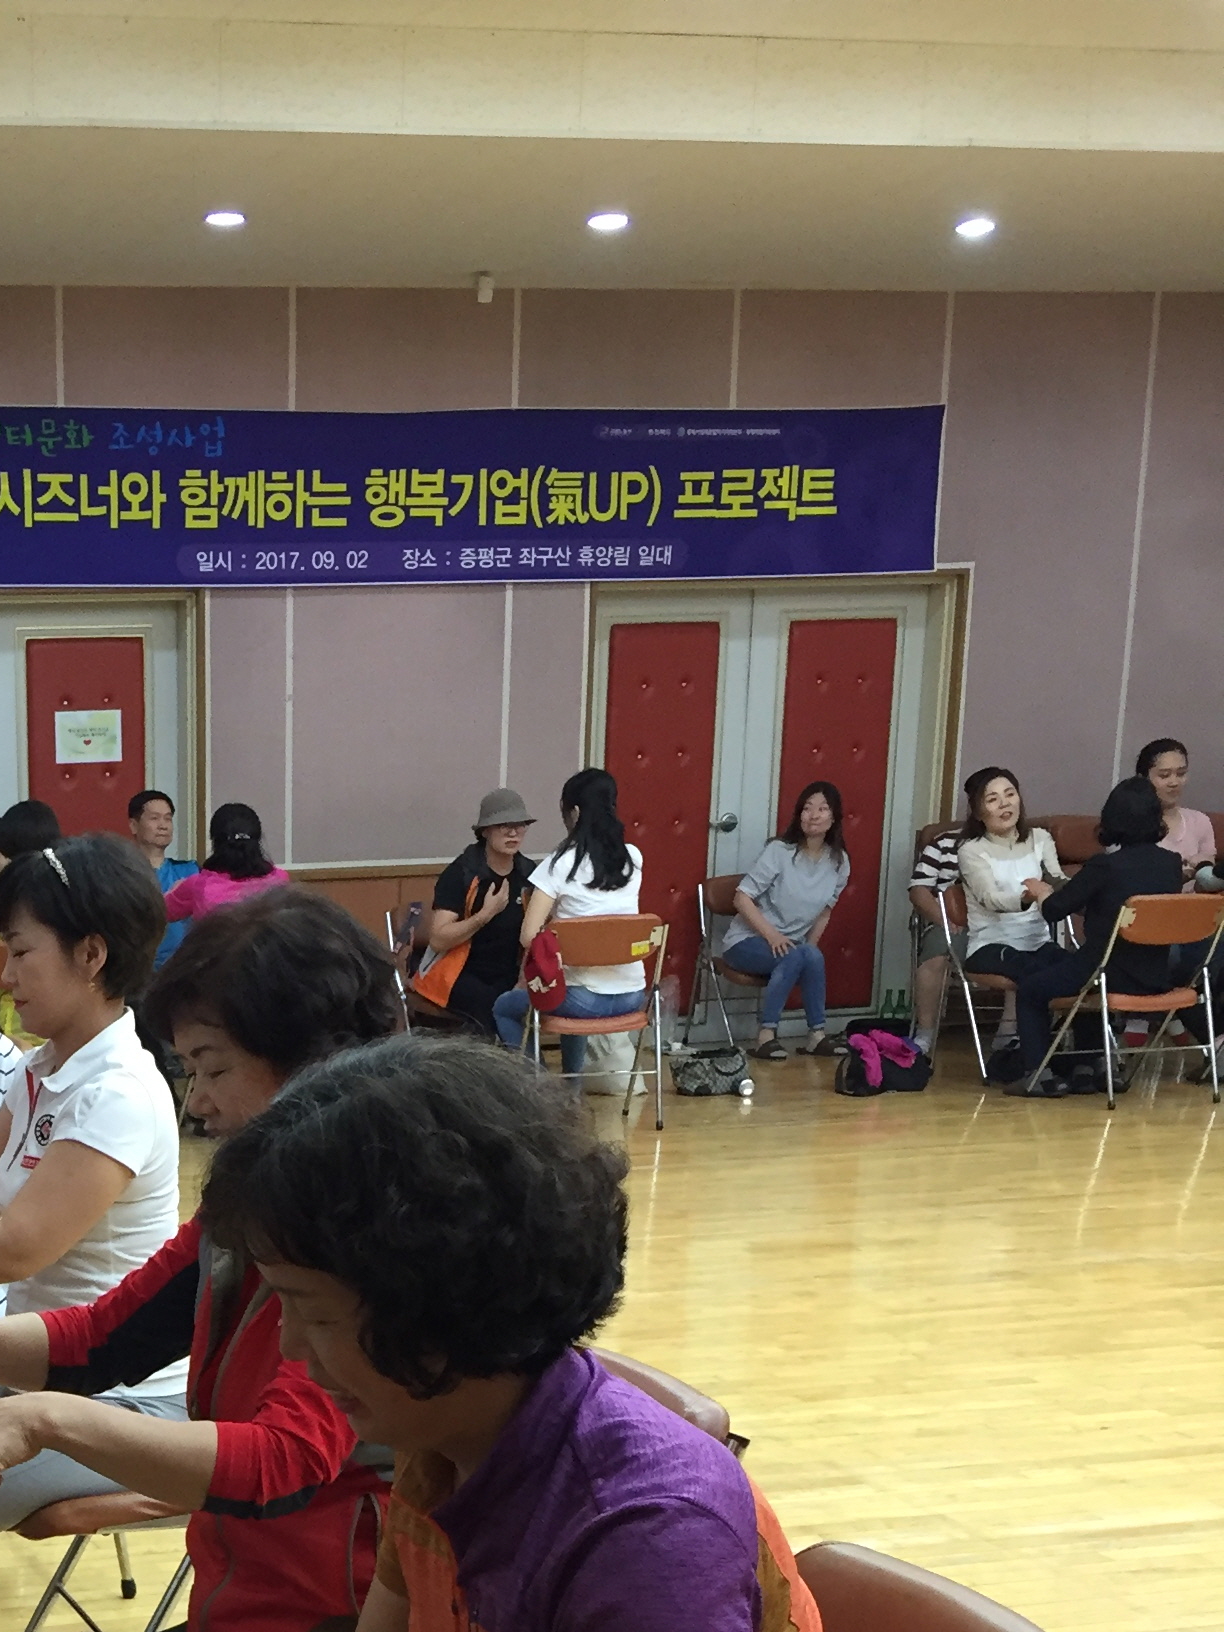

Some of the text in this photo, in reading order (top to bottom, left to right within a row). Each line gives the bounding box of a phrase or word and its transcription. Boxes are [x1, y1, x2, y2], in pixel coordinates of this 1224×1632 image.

[108, 415, 225, 458] 조성사업
[179, 469, 351, 528] 함께하는
[365, 465, 662, 528] 행복기업(氣UP)
[673, 465, 837, 521] 프로젝트
[196, 550, 232, 572] 일시
[255, 551, 305, 571] 2017.
[311, 552, 340, 571] 09.
[346, 550, 369, 569] 02
[402, 548, 437, 570] 장소
[458, 547, 512, 568] 증평군
[518, 546, 571, 567] 좌구산
[577, 545, 630, 567] 휴양림
[638, 544, 673, 566] 일대
